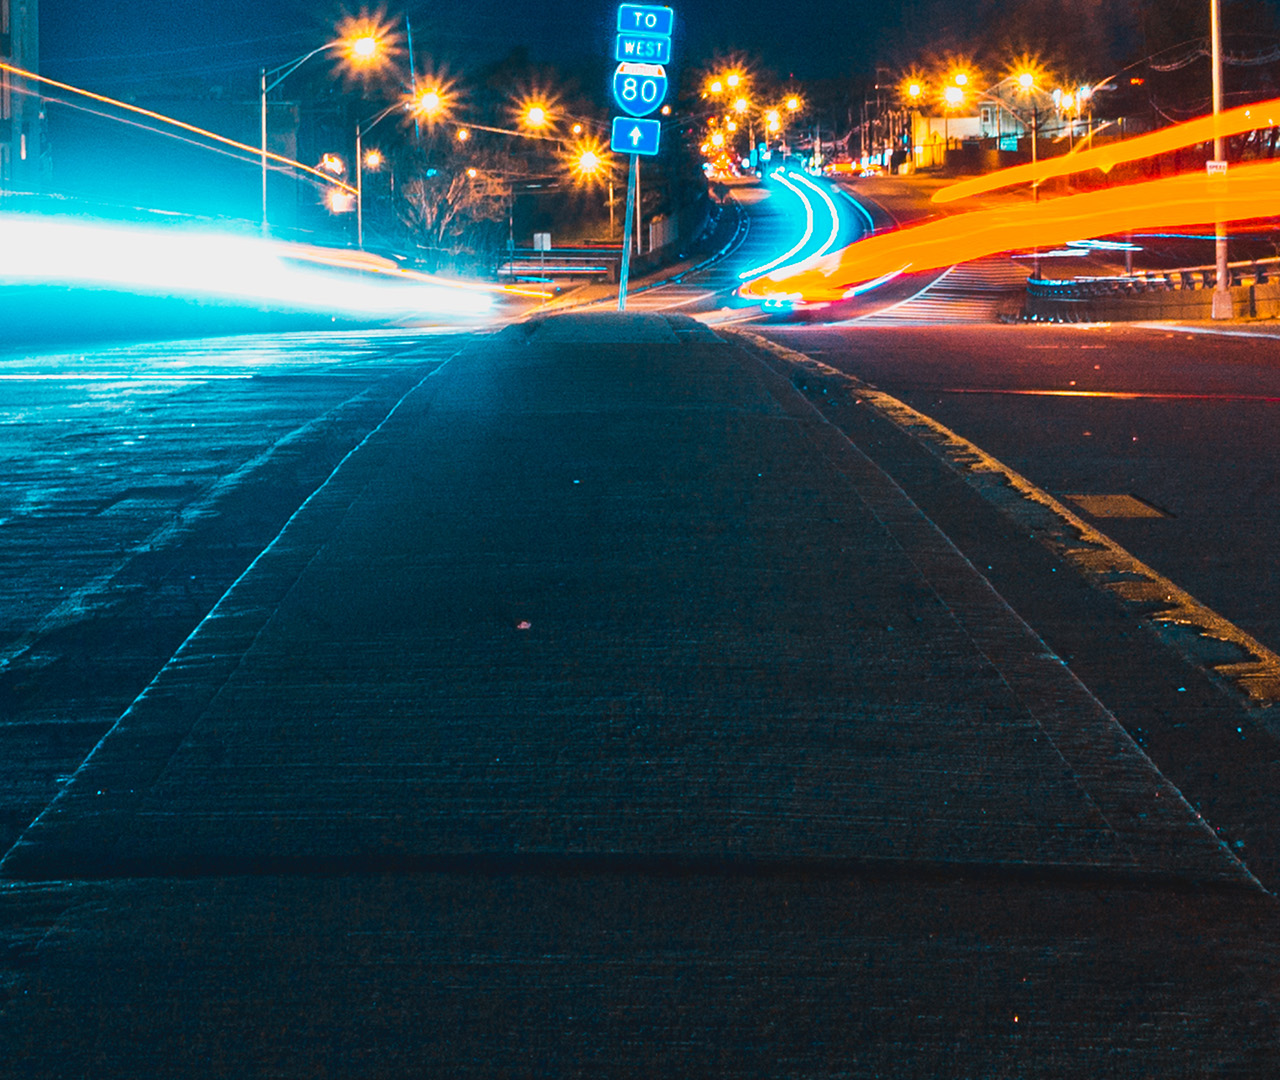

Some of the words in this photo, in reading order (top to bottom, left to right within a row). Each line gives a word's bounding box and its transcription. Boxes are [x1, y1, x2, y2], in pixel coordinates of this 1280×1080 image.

[633, 12, 657, 28] TO
[624, 41, 664, 58] WEST
[622, 77, 657, 102] 80
